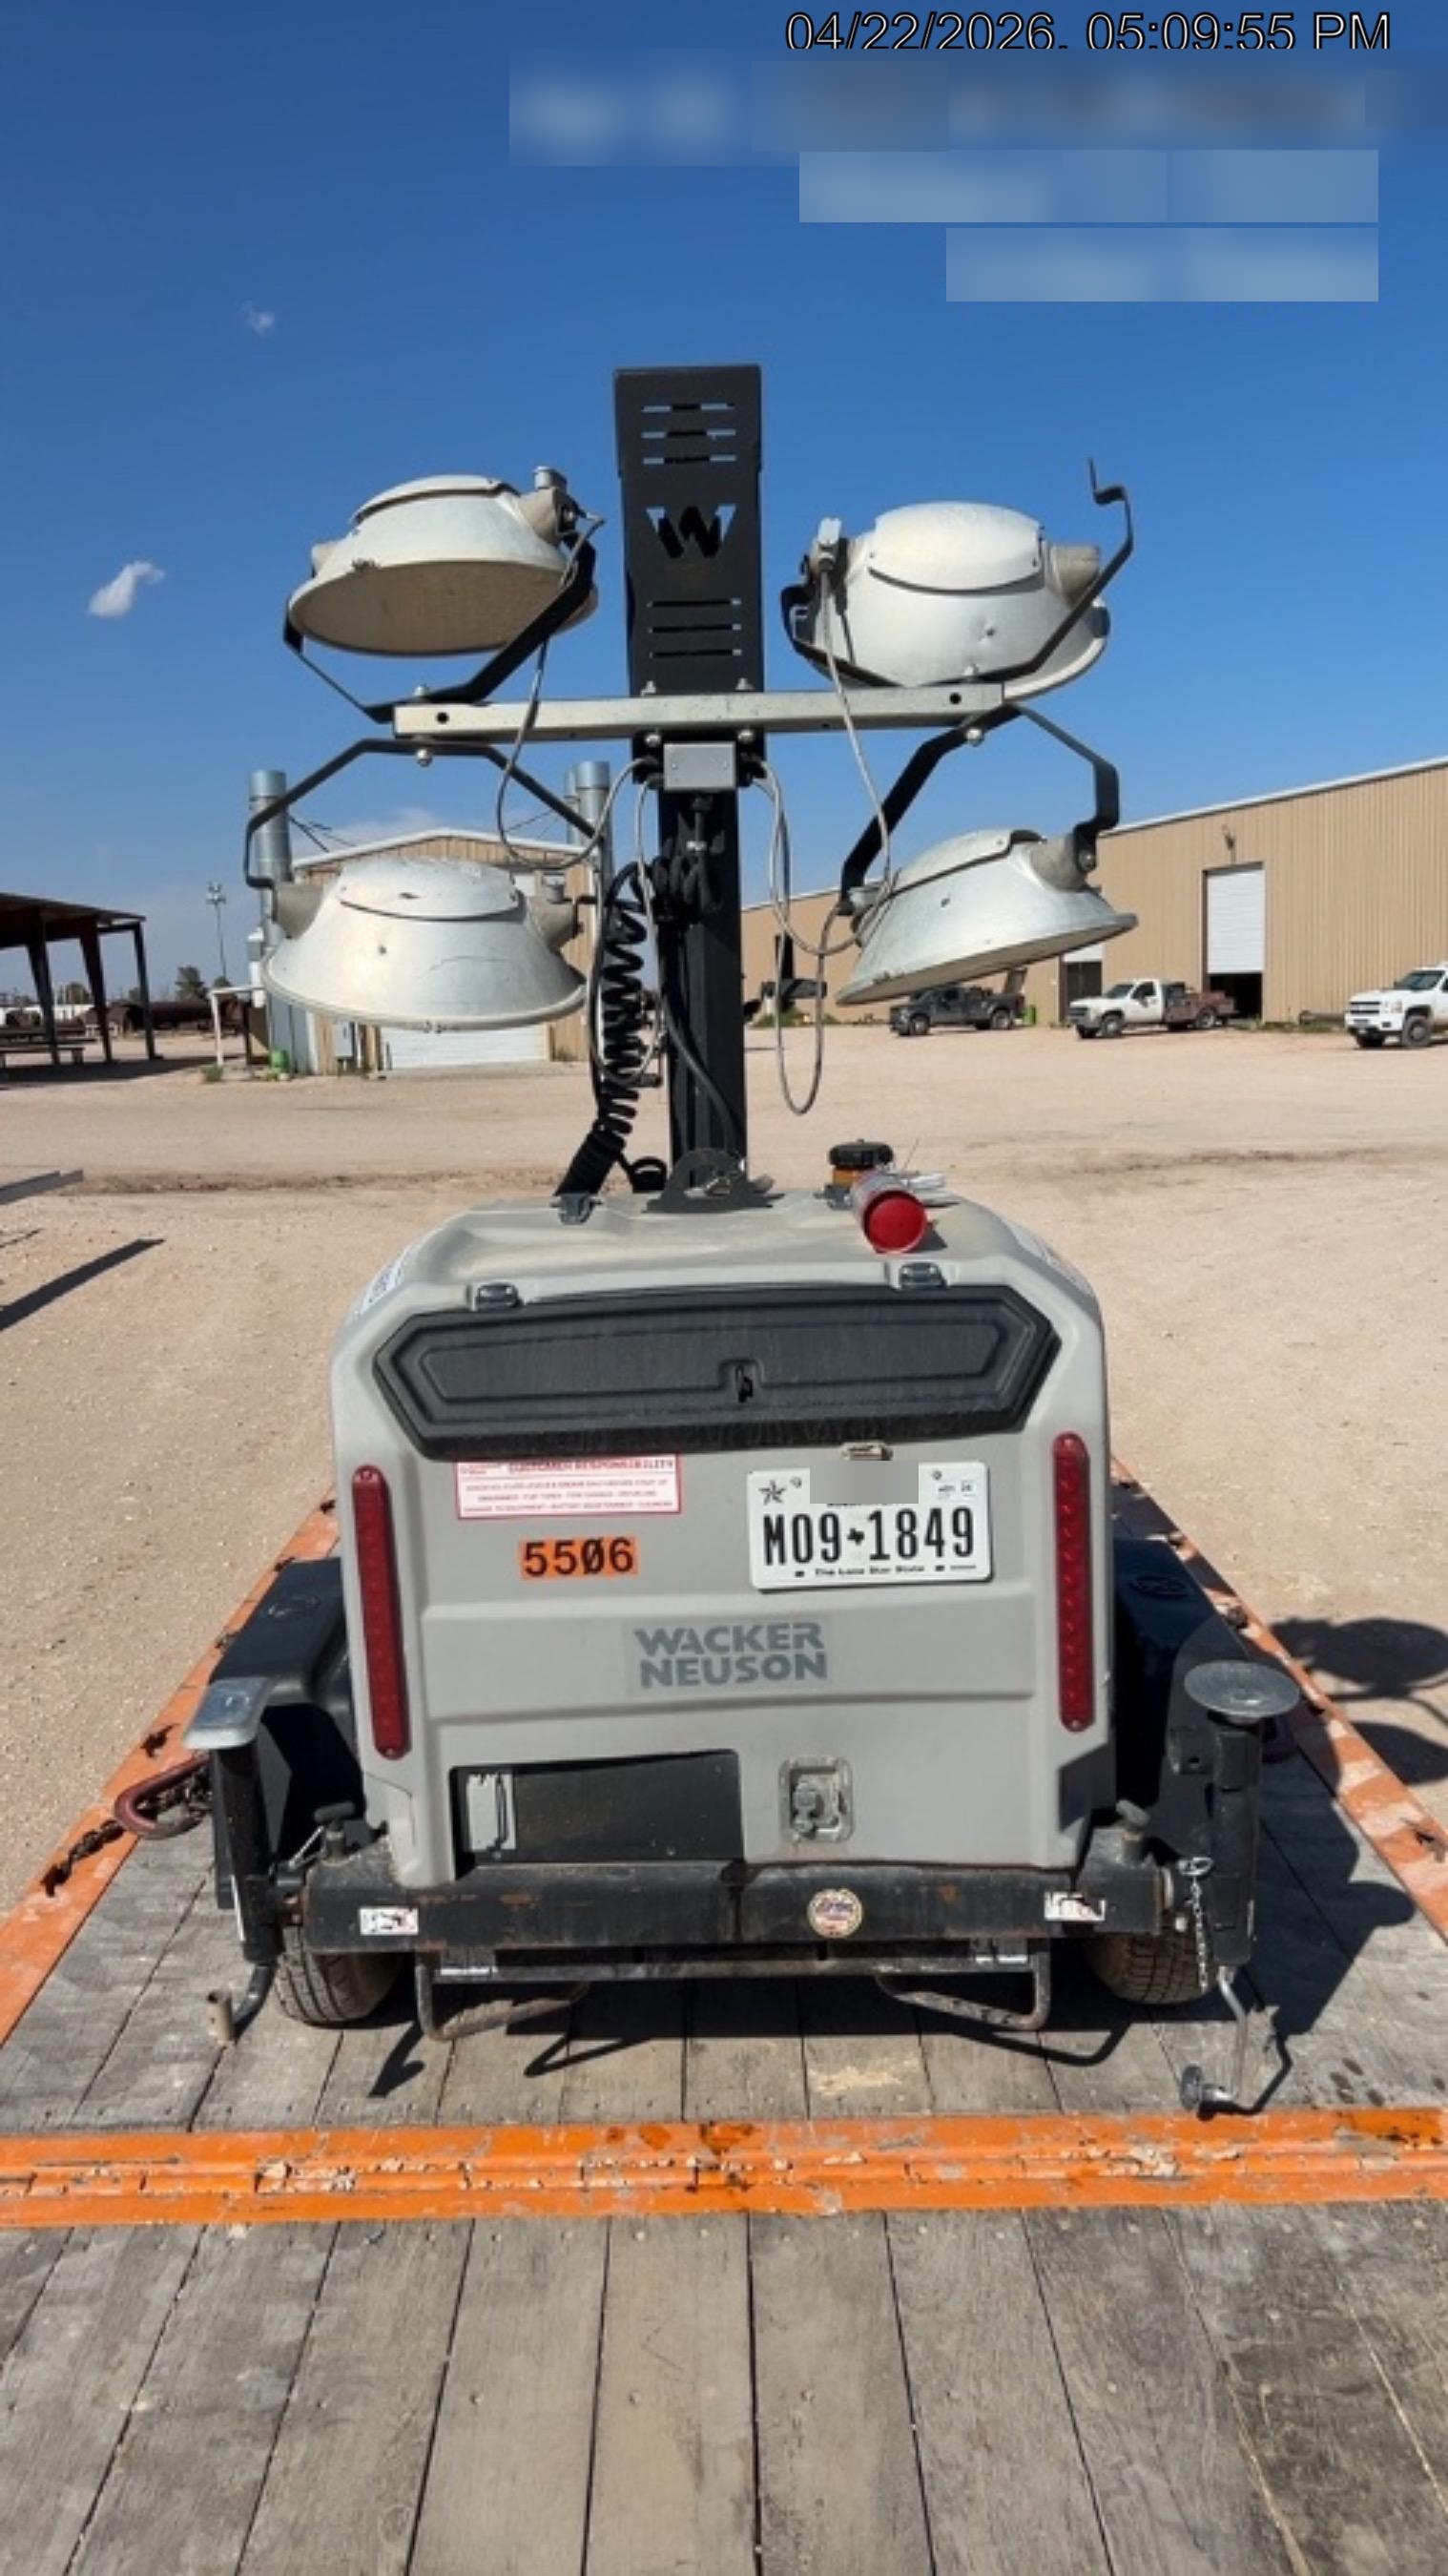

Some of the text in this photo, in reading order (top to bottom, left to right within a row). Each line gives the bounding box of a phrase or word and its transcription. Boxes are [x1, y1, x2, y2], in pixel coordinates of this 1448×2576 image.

[524, 1536, 633, 1575] 5506
[633, 1622, 825, 1657] WACKER
[640, 1652, 828, 1688] NEUSON
